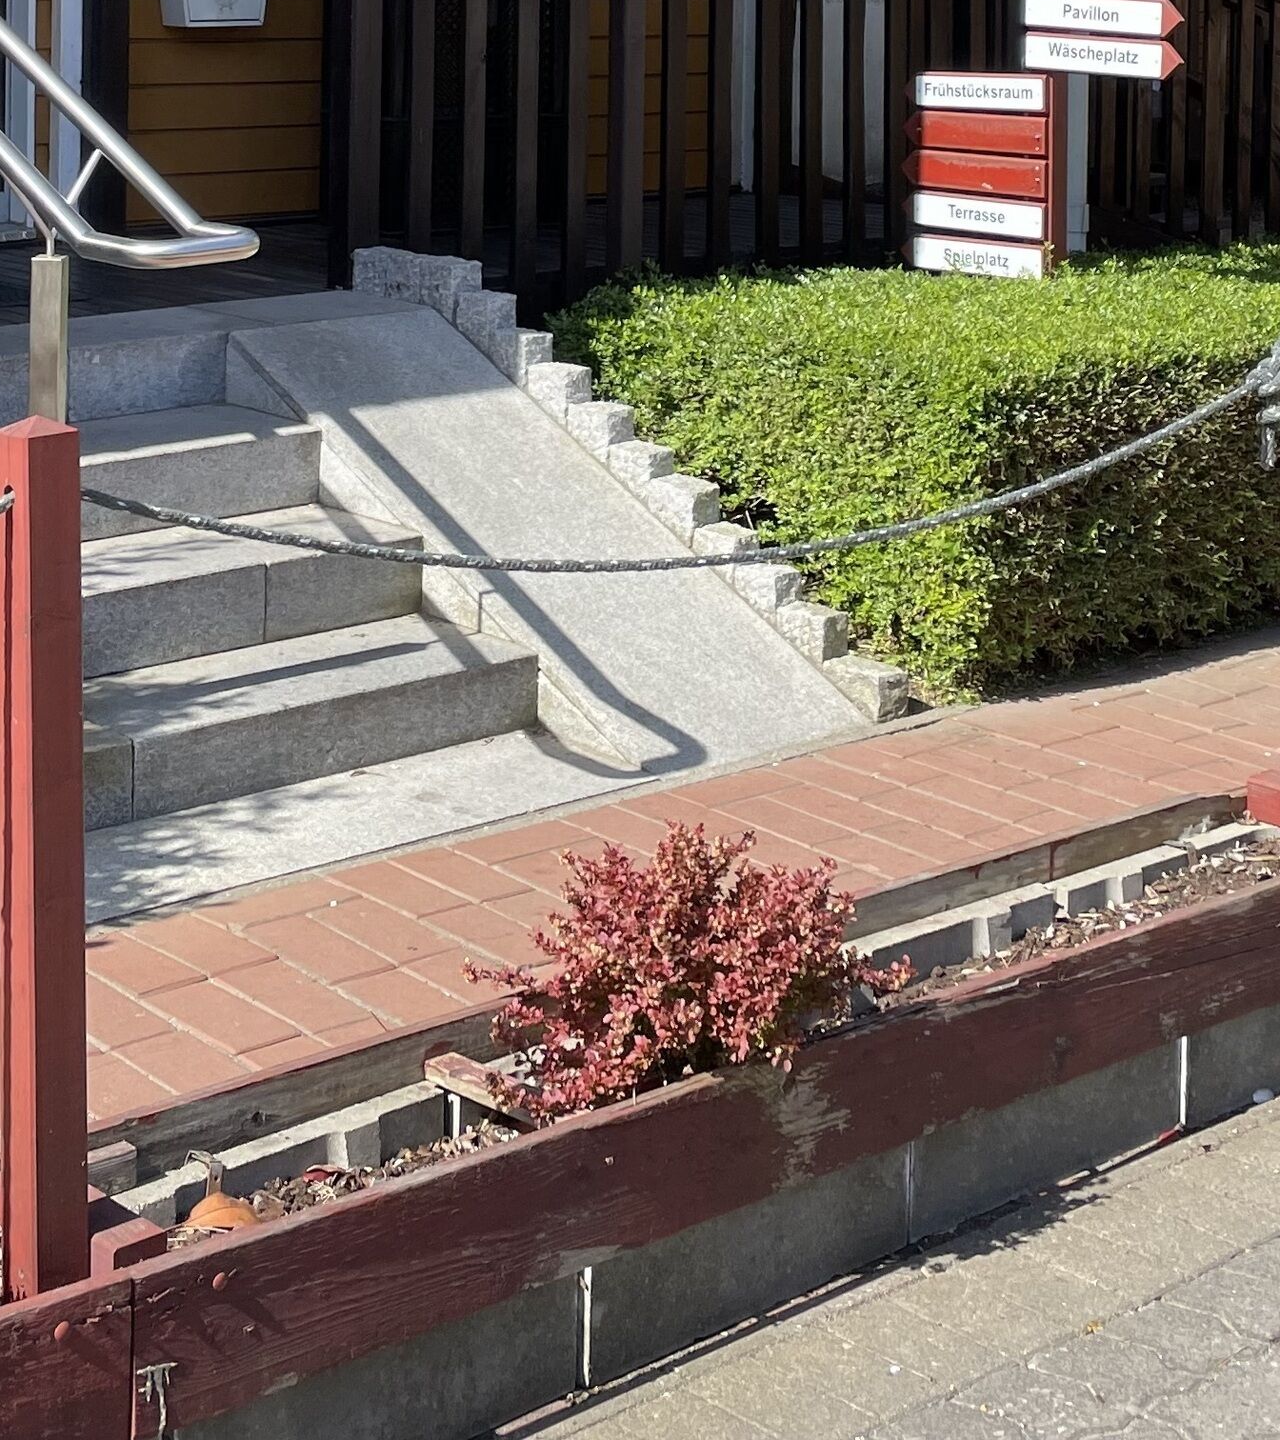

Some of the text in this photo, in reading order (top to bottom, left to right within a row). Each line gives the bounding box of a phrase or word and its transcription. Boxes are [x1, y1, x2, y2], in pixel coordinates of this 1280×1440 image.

[1063, 4, 1119, 22] Pavillon
[1049, 42, 1138, 64] Wäscheplatz
[924, 83, 1033, 99] Frühstücksraum
[948, 204, 1005, 223] Terrasse
[944, 248, 1008, 269] Spielplatz
